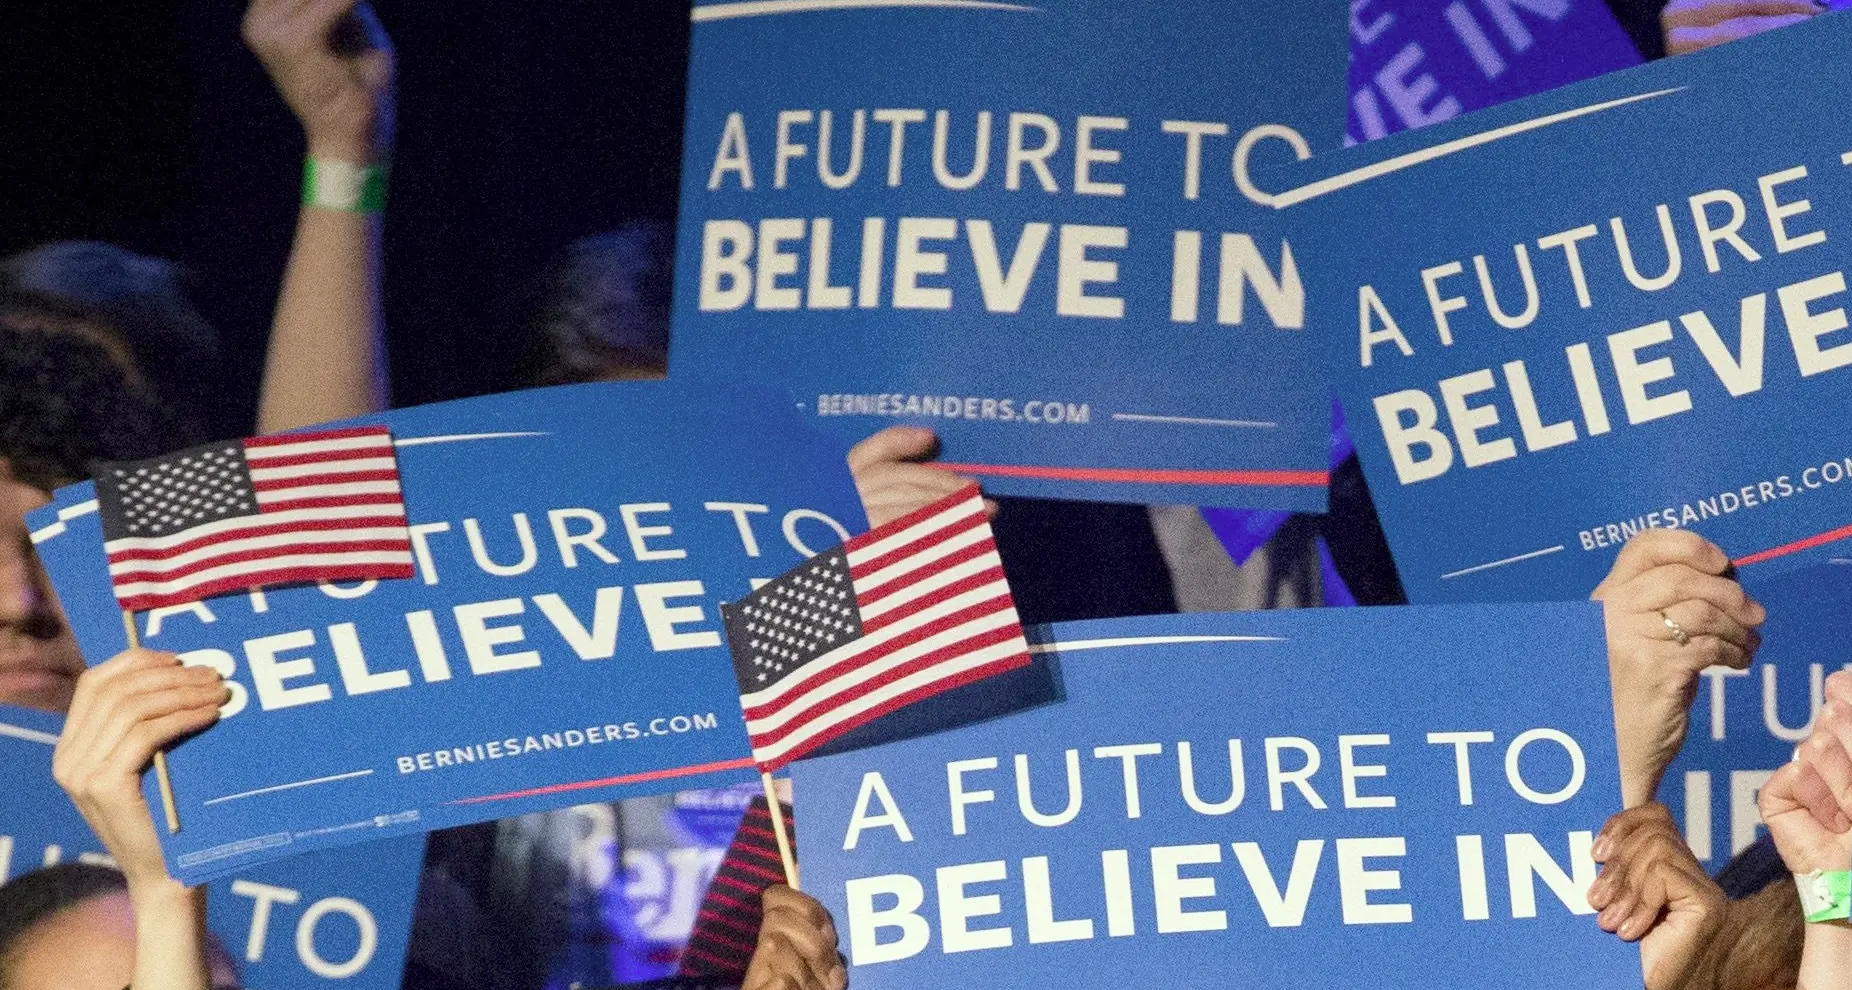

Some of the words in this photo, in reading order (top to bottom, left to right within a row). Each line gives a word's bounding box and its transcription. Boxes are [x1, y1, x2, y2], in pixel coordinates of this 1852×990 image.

[710, 114, 752, 188] A
[776, 110, 1126, 195] FUTURE
[1162, 120, 1312, 206] TO
[700, 218, 1127, 318] BELIEVE
[1172, 231, 1304, 328] IN
[1360, 286, 1413, 366] A
[1422, 166, 1826, 345] FUTURE
[817, 393, 1091, 424] BERNIESANDERS.COM
[250, 502, 687, 613] TURE
[178, 579, 722, 719] BELIEVE
[397, 712, 718, 776] BERNIESANDERS.COM
[843, 772, 913, 850] A
[947, 735, 1395, 835] FUTURE
[1427, 729, 1585, 805] TO
[231, 880, 378, 979] TO
[845, 837, 1412, 966] BELIEVE
[1456, 831, 1598, 920] IN
